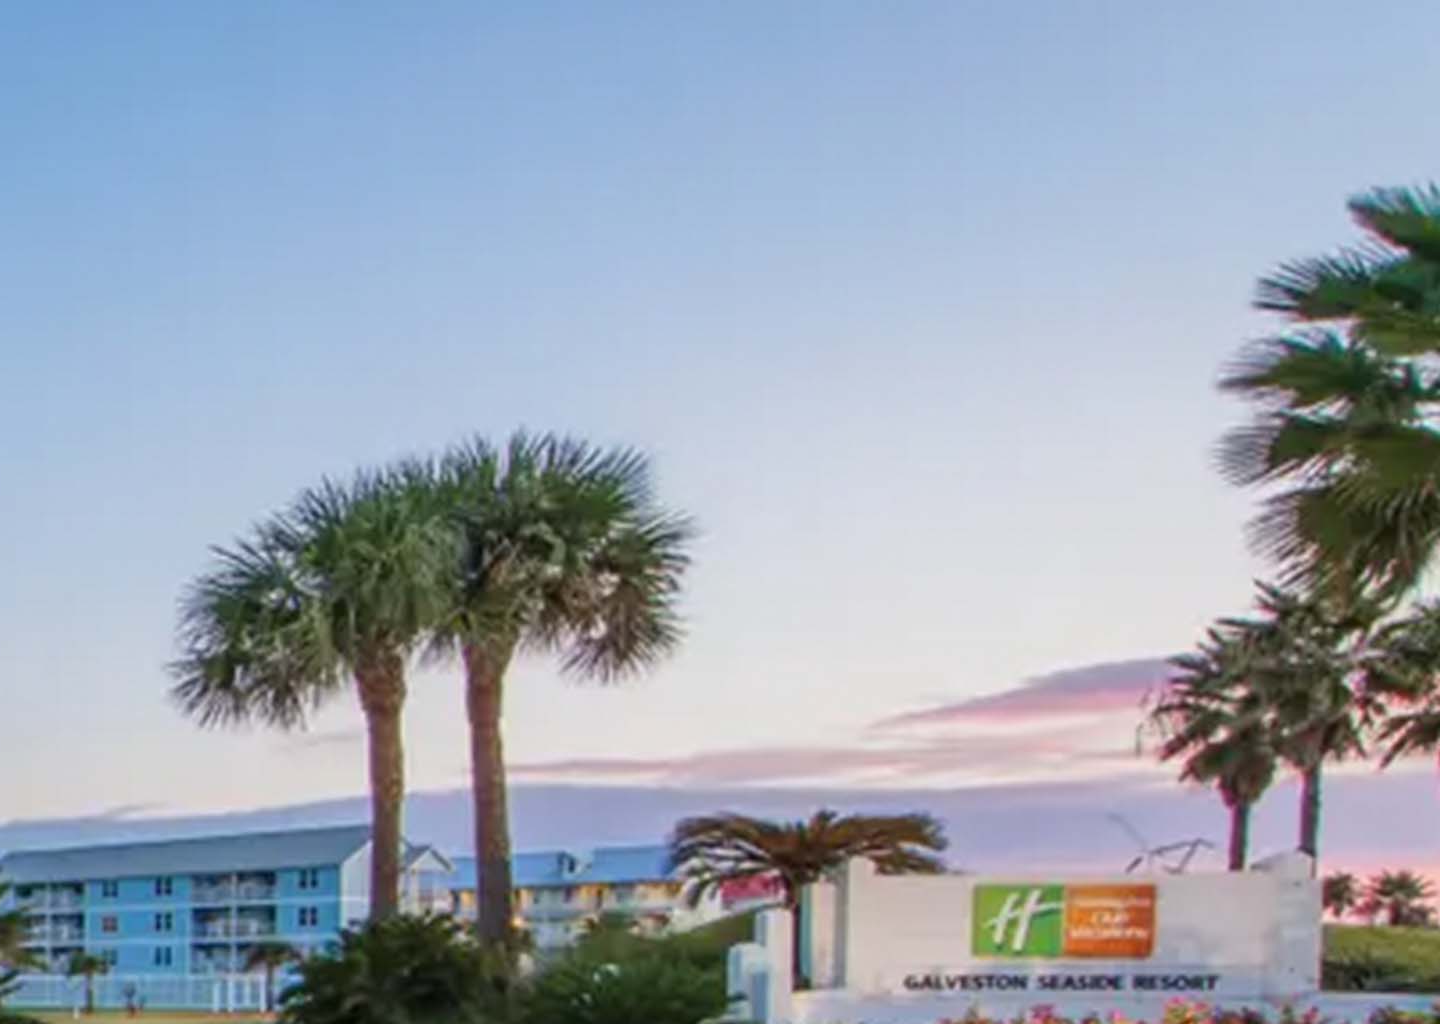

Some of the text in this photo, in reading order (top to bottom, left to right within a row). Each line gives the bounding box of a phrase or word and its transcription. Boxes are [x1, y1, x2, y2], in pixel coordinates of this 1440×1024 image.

[903, 973, 1219, 990] GALVESTON SEASIDE RESORT
